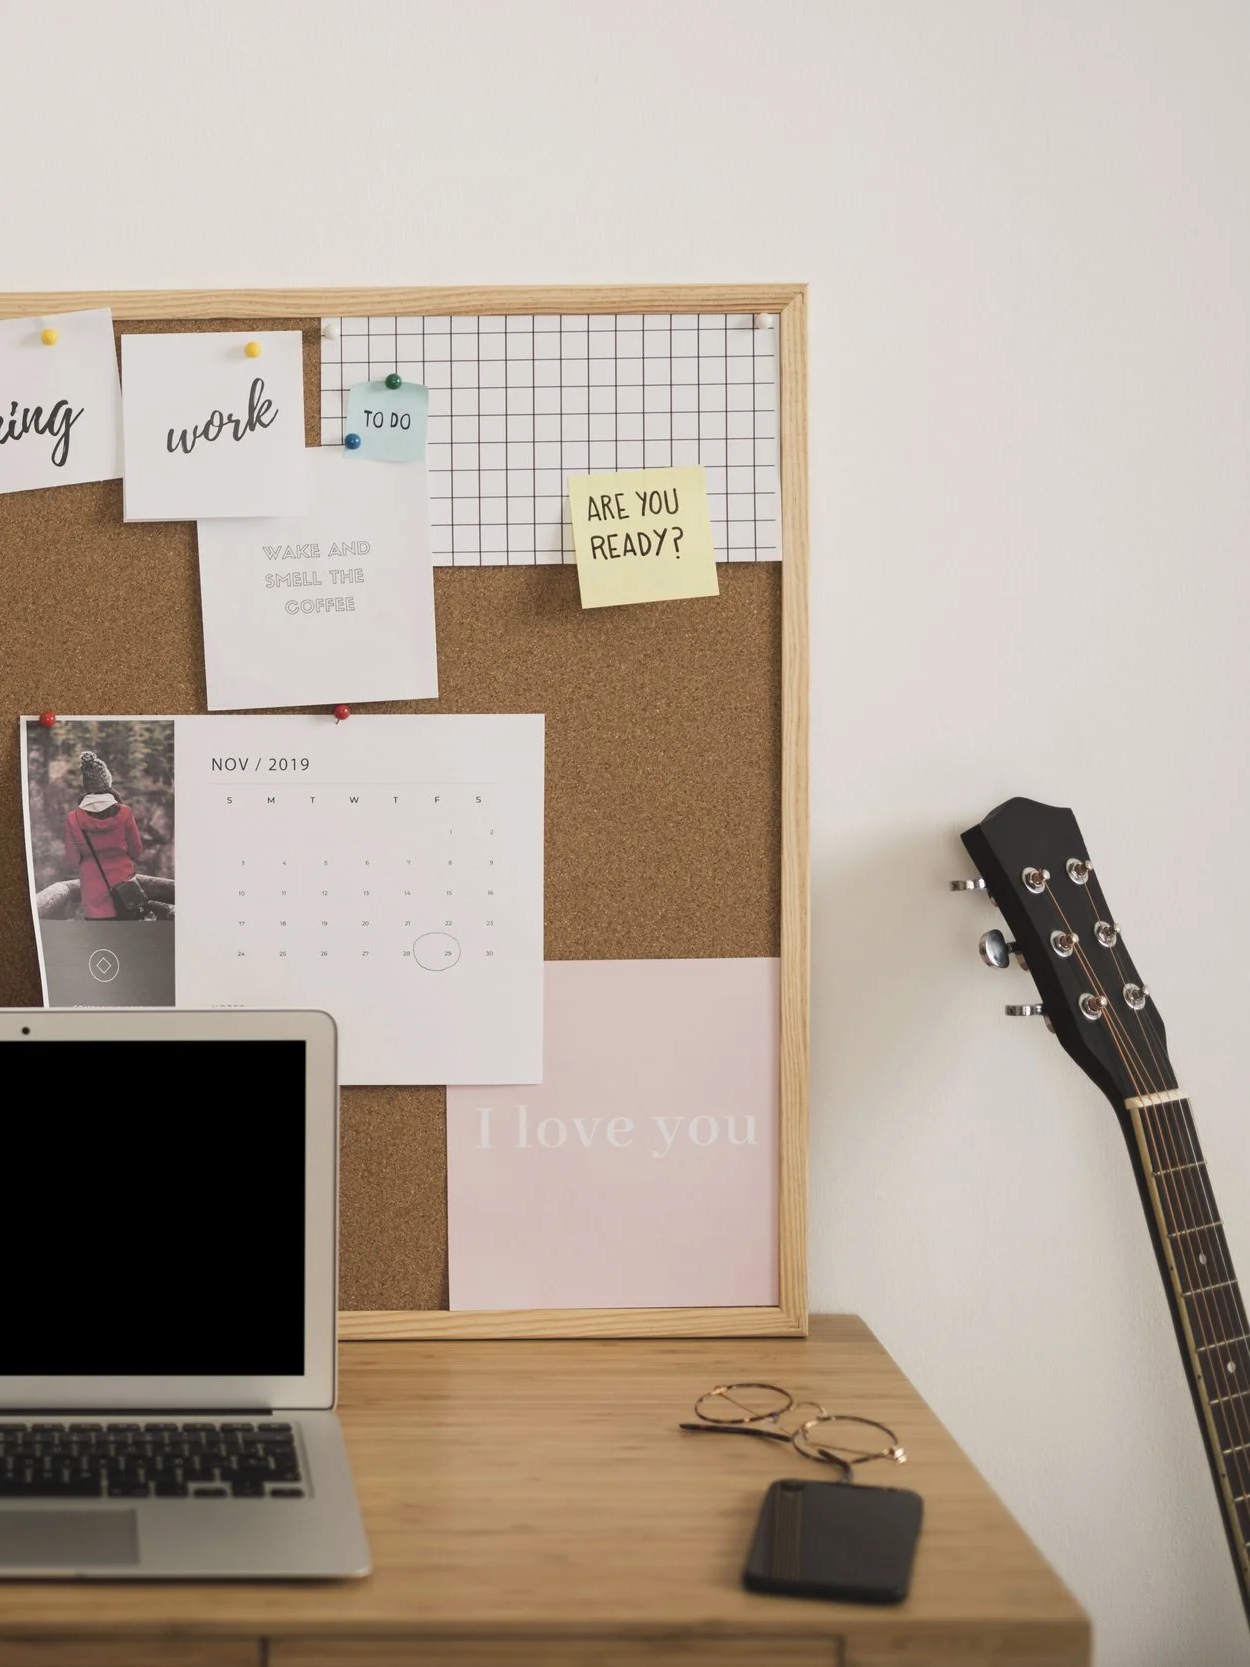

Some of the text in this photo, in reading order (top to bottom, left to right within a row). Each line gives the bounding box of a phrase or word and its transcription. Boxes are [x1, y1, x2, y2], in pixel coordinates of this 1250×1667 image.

[166, 377, 279, 455] work
[363, 409, 411, 431] TO DO
[587, 487, 679, 522] ARE YOU
[261, 540, 371, 561] WAKE AND
[590, 526, 684, 561] READY?
[264, 567, 365, 589] SMELL THE
[284, 596, 356, 616] COFFEE
[211, 757, 249, 772] NOV
[268, 757, 310, 772] 2019
[226, 795, 482, 805] S M T W T F S
[475, 1104, 760, 1159] I love you
